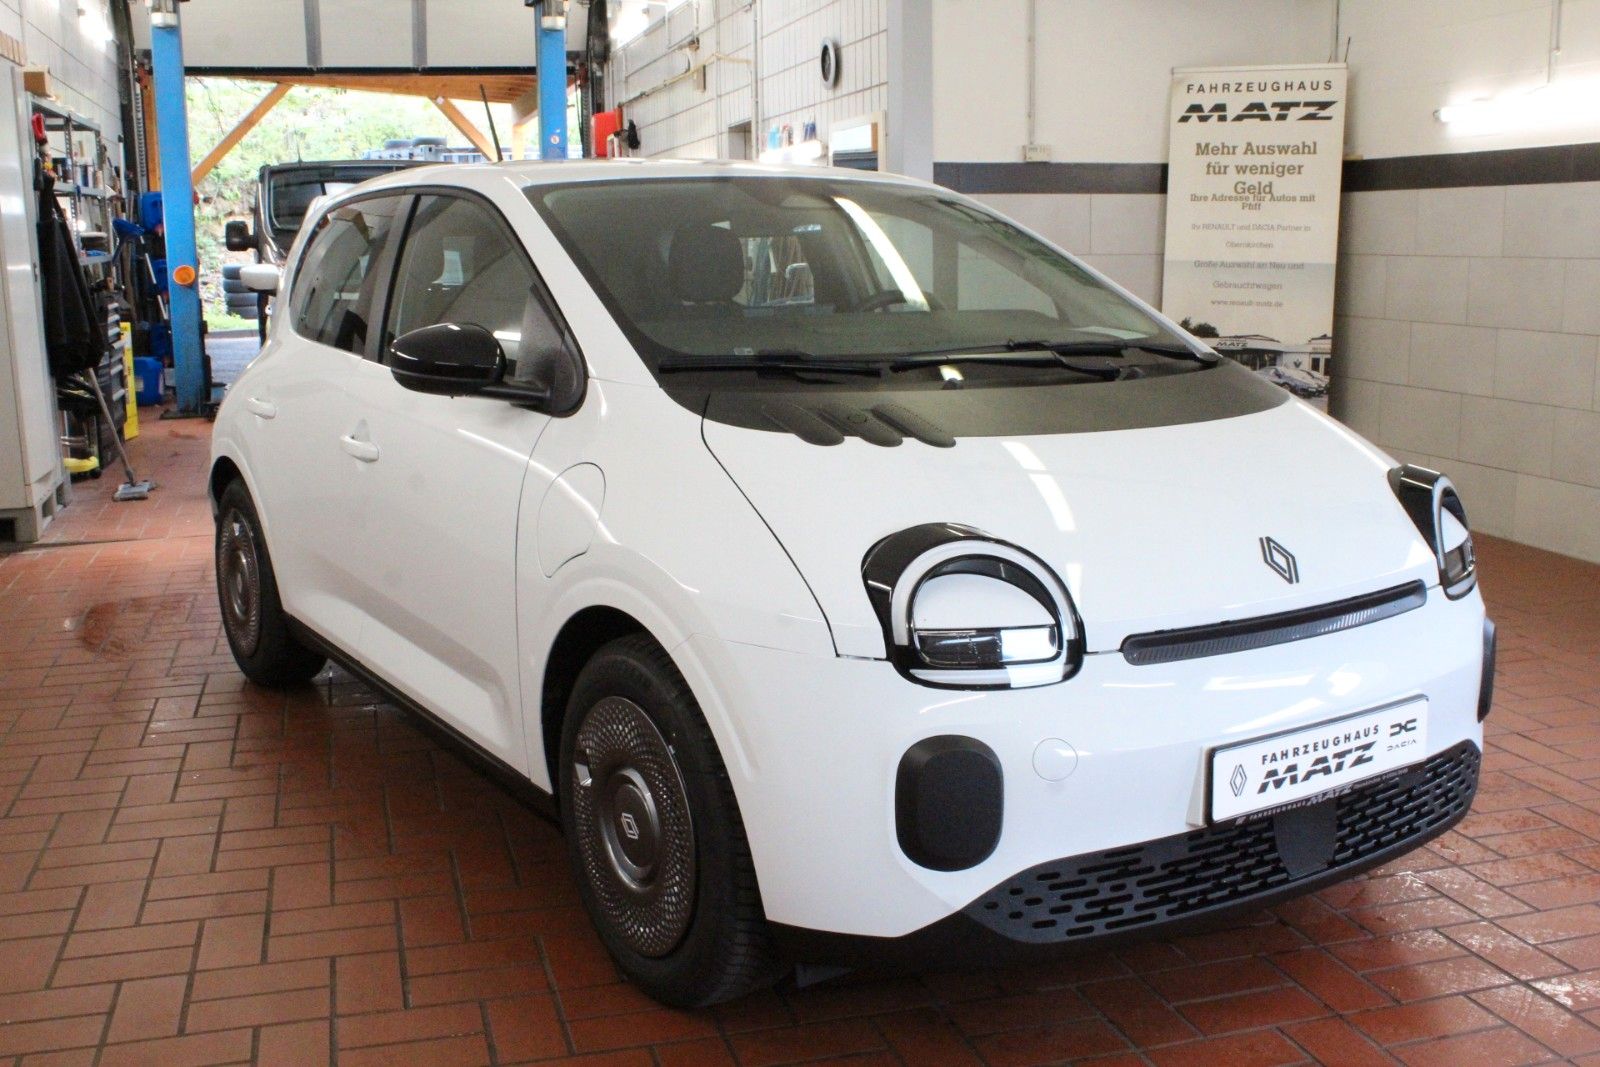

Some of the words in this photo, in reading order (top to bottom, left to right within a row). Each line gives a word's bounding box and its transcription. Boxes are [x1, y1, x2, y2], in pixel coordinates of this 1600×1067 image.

[1186, 80, 1333, 94] FAHRZEUGHAUS
[1177, 100, 1339, 123] MATZ
[1195, 142, 1239, 156] Mehr
[1243, 141, 1317, 155] Auswahl
[1206, 162, 1230, 175] für
[1235, 162, 1304, 178] weniger
[1233, 181, 1273, 195] Geld
[1190, 193, 1209, 202] Ihre
[1211, 193, 1250, 202] Adresse
[1253, 194, 1266, 202] für
[1269, 194, 1297, 202] Autos
[1299, 194, 1316, 202] mit
[1202, 223, 1235, 231] RENAULT
[1236, 223, 1251, 231] und
[1252, 223, 1275, 231] DACIA
[1276, 224, 1303, 232] Partner
[1304, 224, 1311, 232] in
[1219, 261, 1255, 269] Auswahl
[1256, 261, 1267, 269] an
[1287, 262, 1305, 270] und
[1262, 724, 1379, 766] FAHRZEUGHAUS
[1386, 739, 1417, 752] DACIA
[1257, 740, 1377, 795] MATZ
